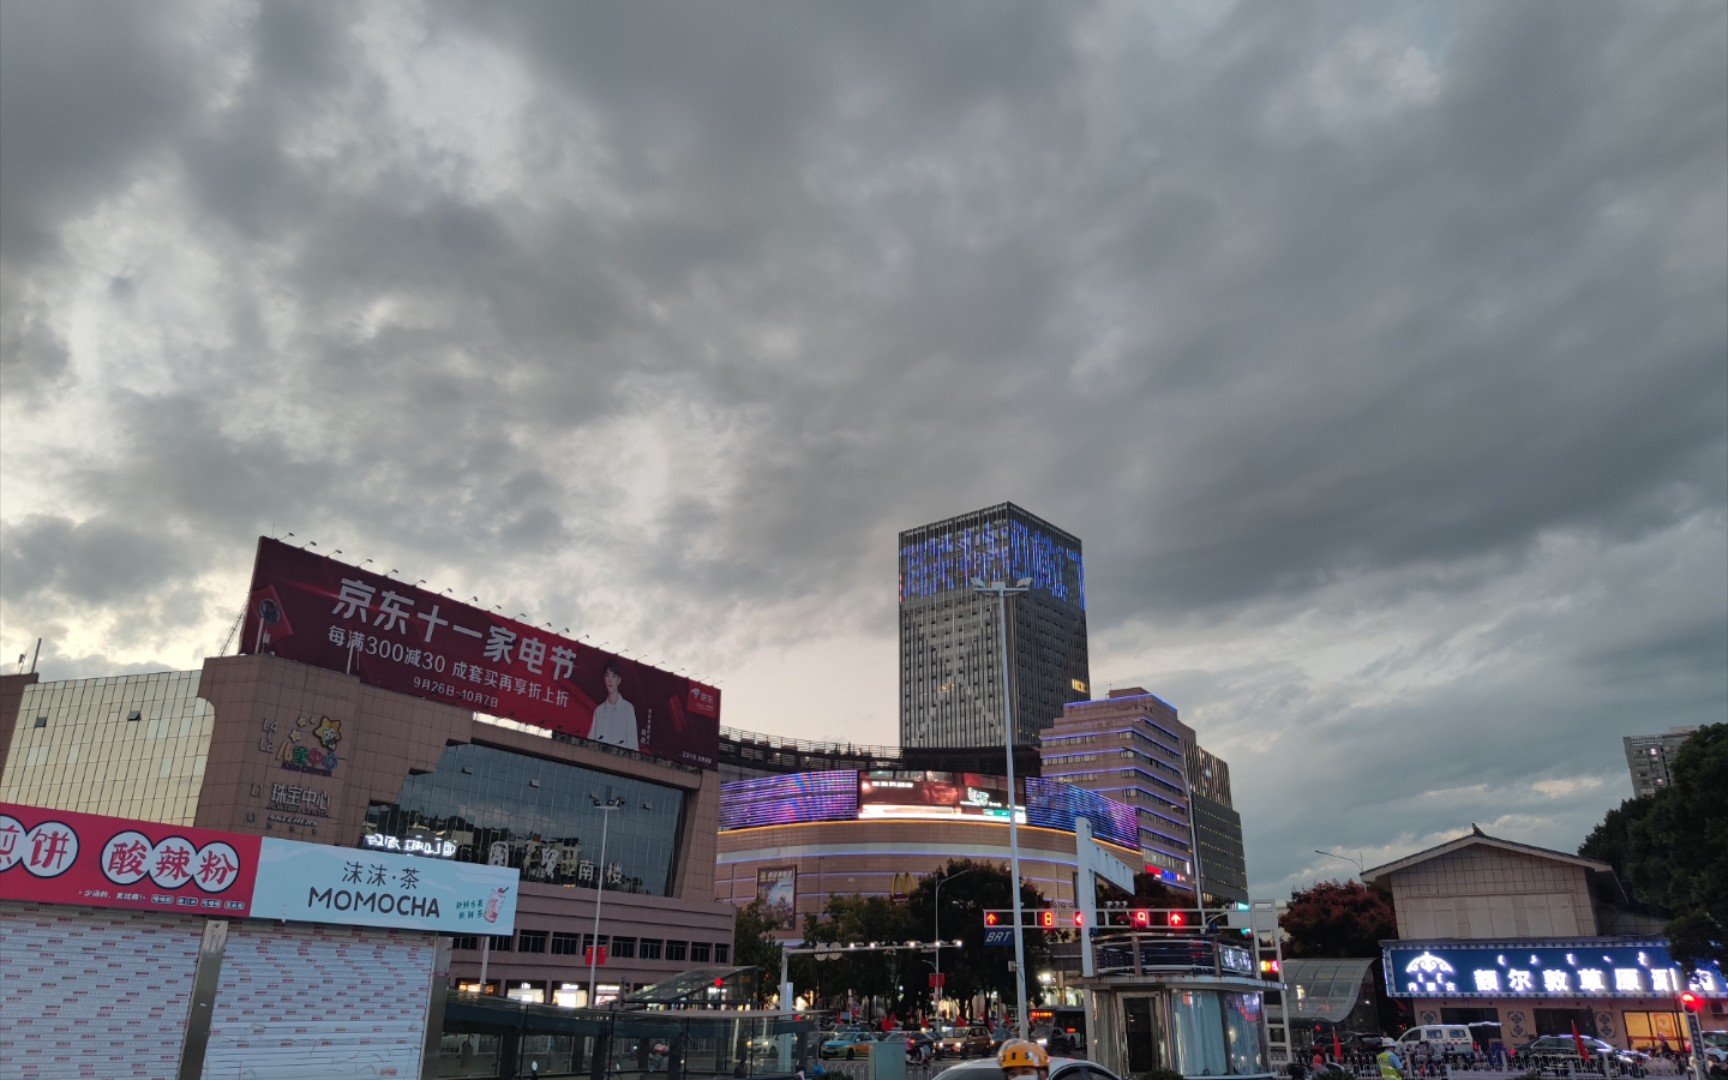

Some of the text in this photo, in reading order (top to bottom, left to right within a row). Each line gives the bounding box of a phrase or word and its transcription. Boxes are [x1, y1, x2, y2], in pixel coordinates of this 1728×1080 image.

[332, 578, 577, 680] 京东十一家电节
[327, 626, 569, 708] 每满300减30 成套买再享折上折
[412, 675, 500, 708] 9月26日-10月7日
[276, 742, 338, 769] 儿童中心
[271, 783, 331, 809] 珠宝中心
[107, 839, 238, 885] 酸辣粉
[308, 887, 440, 919] MOMOCHA
[985, 931, 1012, 943] BRT
